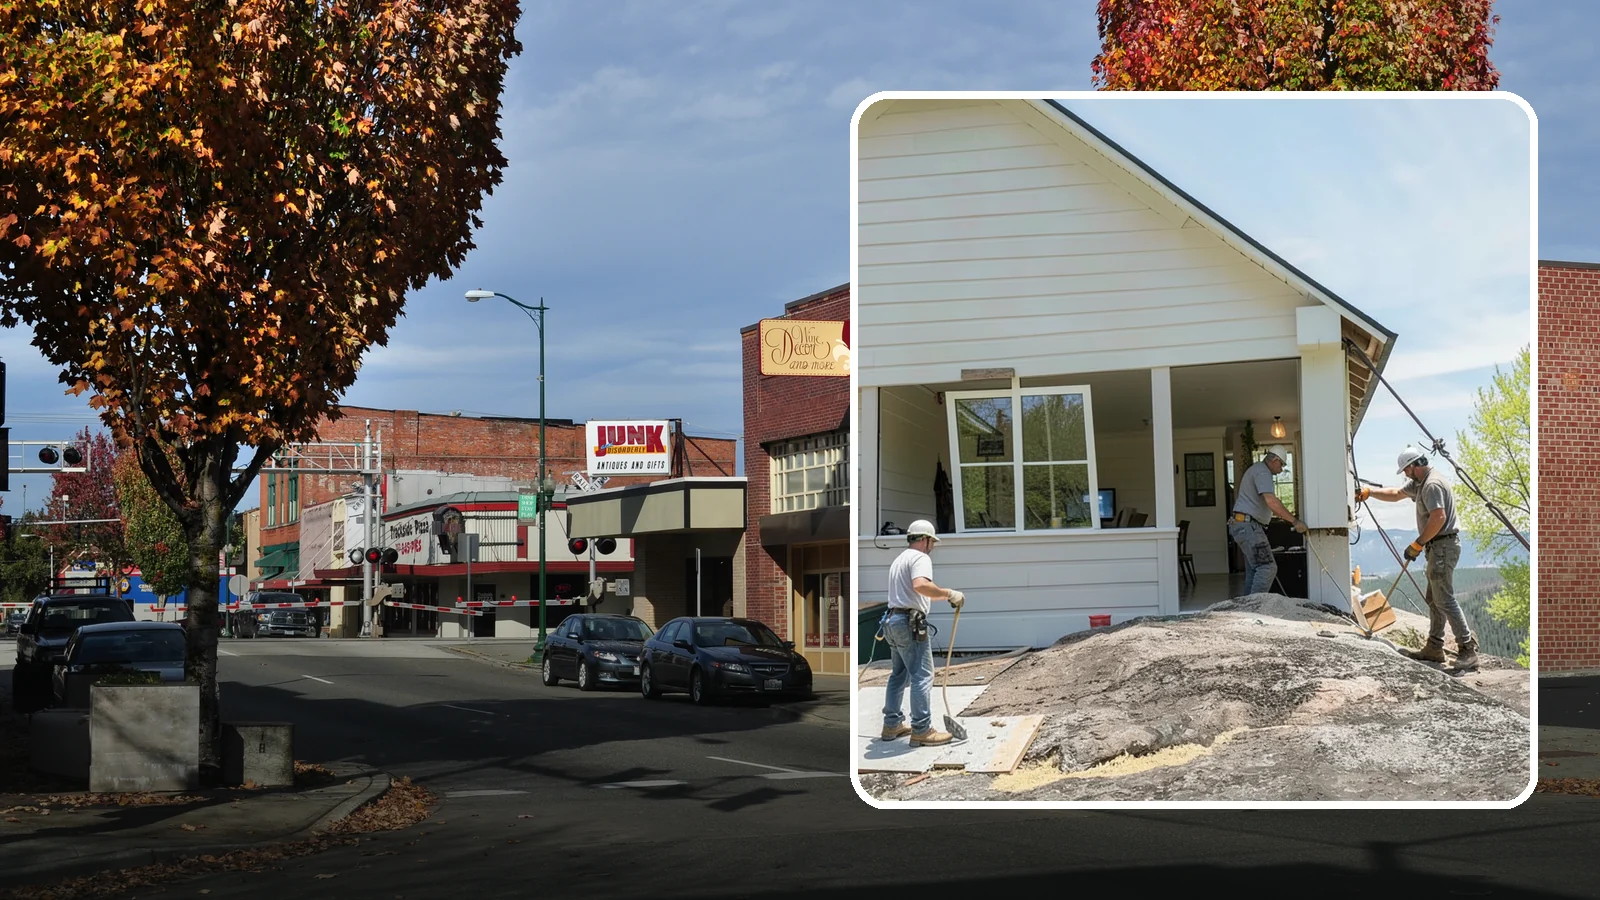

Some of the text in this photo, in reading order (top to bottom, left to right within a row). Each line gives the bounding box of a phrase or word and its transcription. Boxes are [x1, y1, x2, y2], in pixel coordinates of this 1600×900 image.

[765, 327, 831, 365] Decor
[595, 425, 665, 457] JUNK
[607, 446, 646, 454] DISORDERLY
[597, 460, 665, 470] ANTIQUES AND GIFTS
[573, 473, 589, 492] RAIL
[414, 519, 429, 535] Pizza
